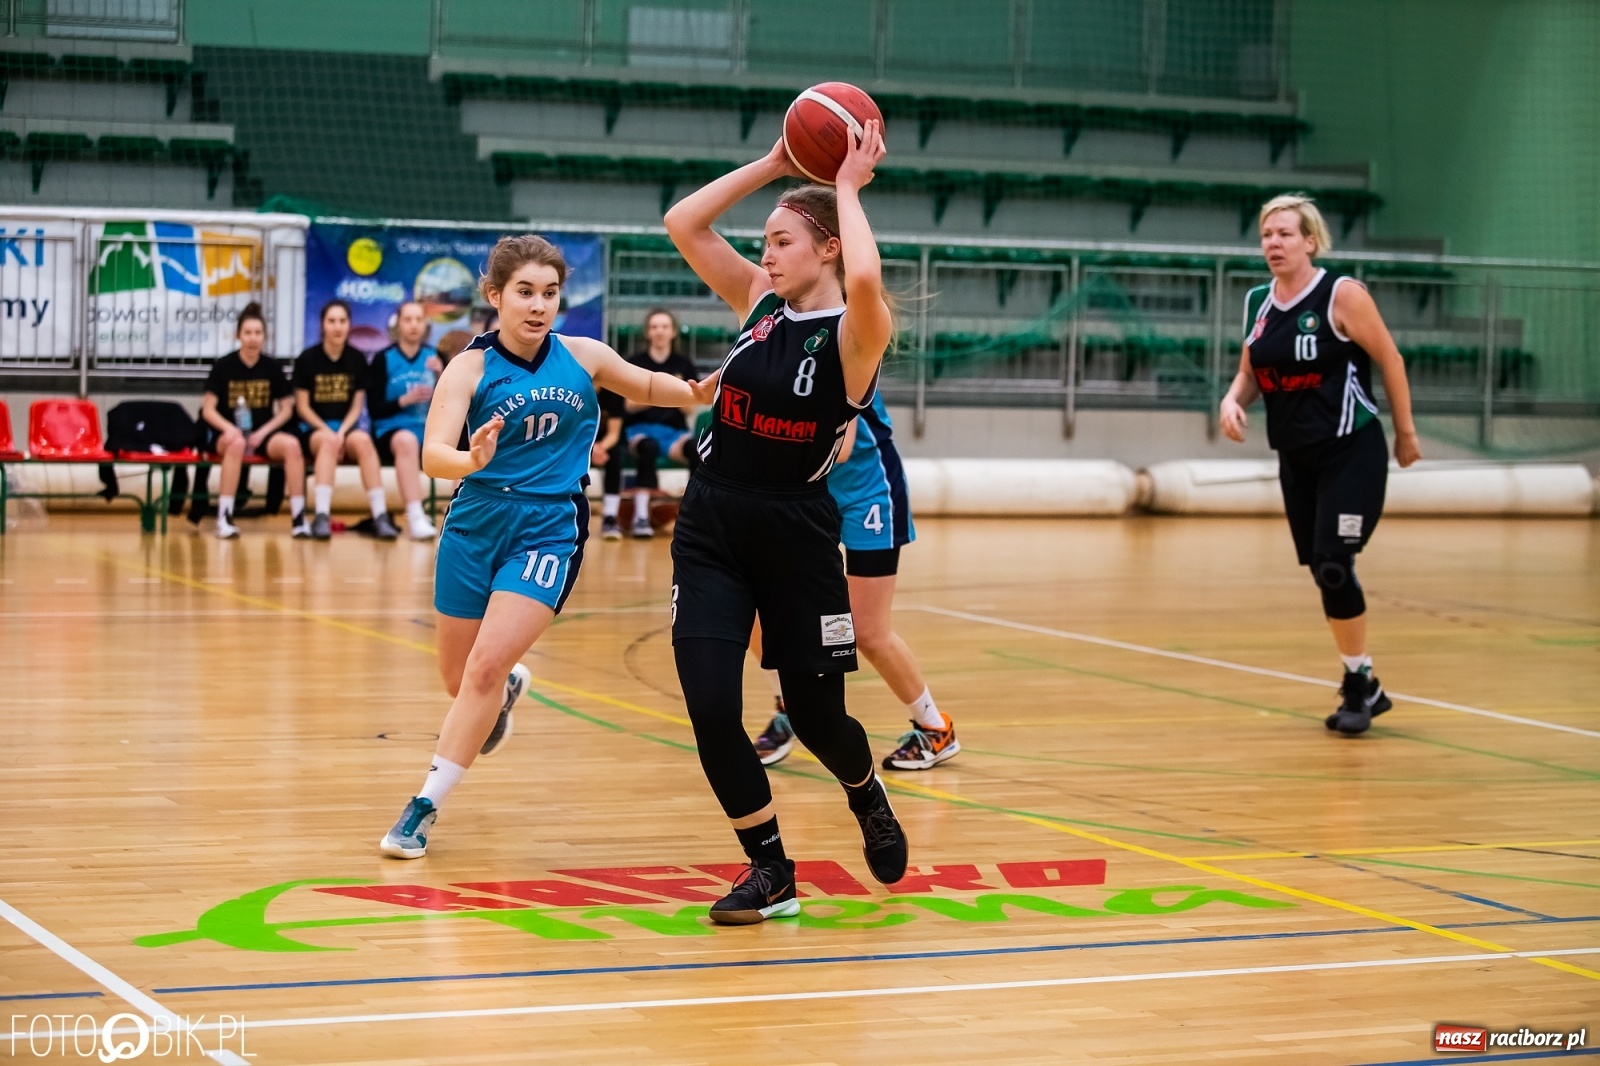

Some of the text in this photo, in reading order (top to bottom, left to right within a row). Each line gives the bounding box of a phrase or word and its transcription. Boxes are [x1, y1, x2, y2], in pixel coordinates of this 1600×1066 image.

[1295, 334, 1318, 361] 10
[792, 356, 817, 397] 8
[530, 386, 585, 413] RZESZÓW
[722, 388, 744, 425] K
[523, 411, 559, 442] 10
[753, 412, 817, 438] KAMAN
[863, 503, 884, 535] 4
[520, 550, 561, 590] 10
